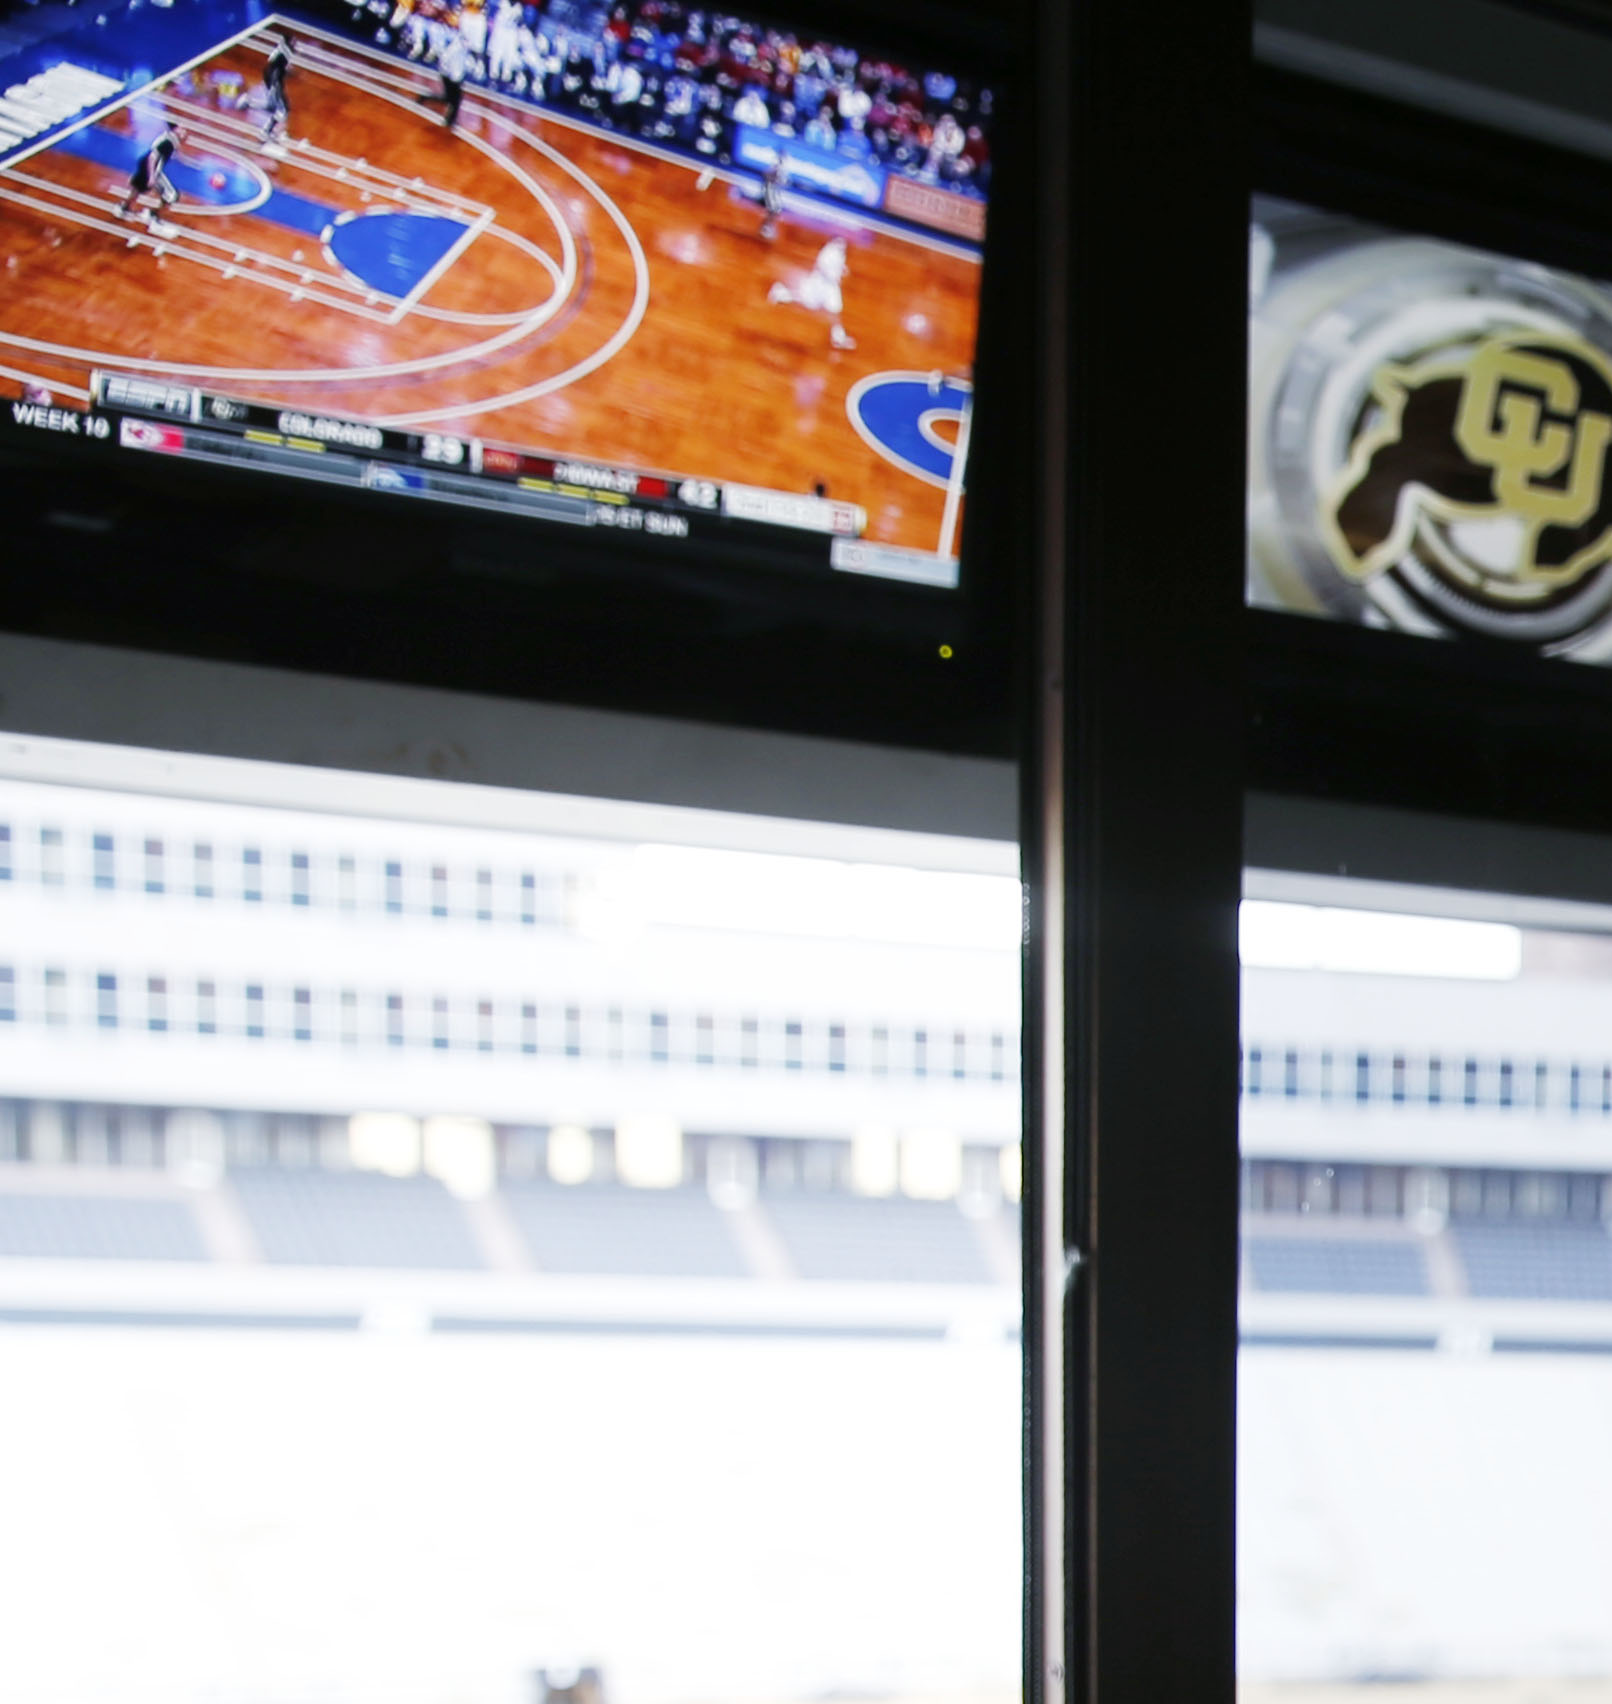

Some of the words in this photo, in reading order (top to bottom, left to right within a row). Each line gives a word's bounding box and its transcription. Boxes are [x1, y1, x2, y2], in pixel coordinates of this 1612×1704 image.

[106, 375, 191, 416] ESPN
[12, 402, 79, 436] WEEK
[278, 411, 384, 450] COLORADO
